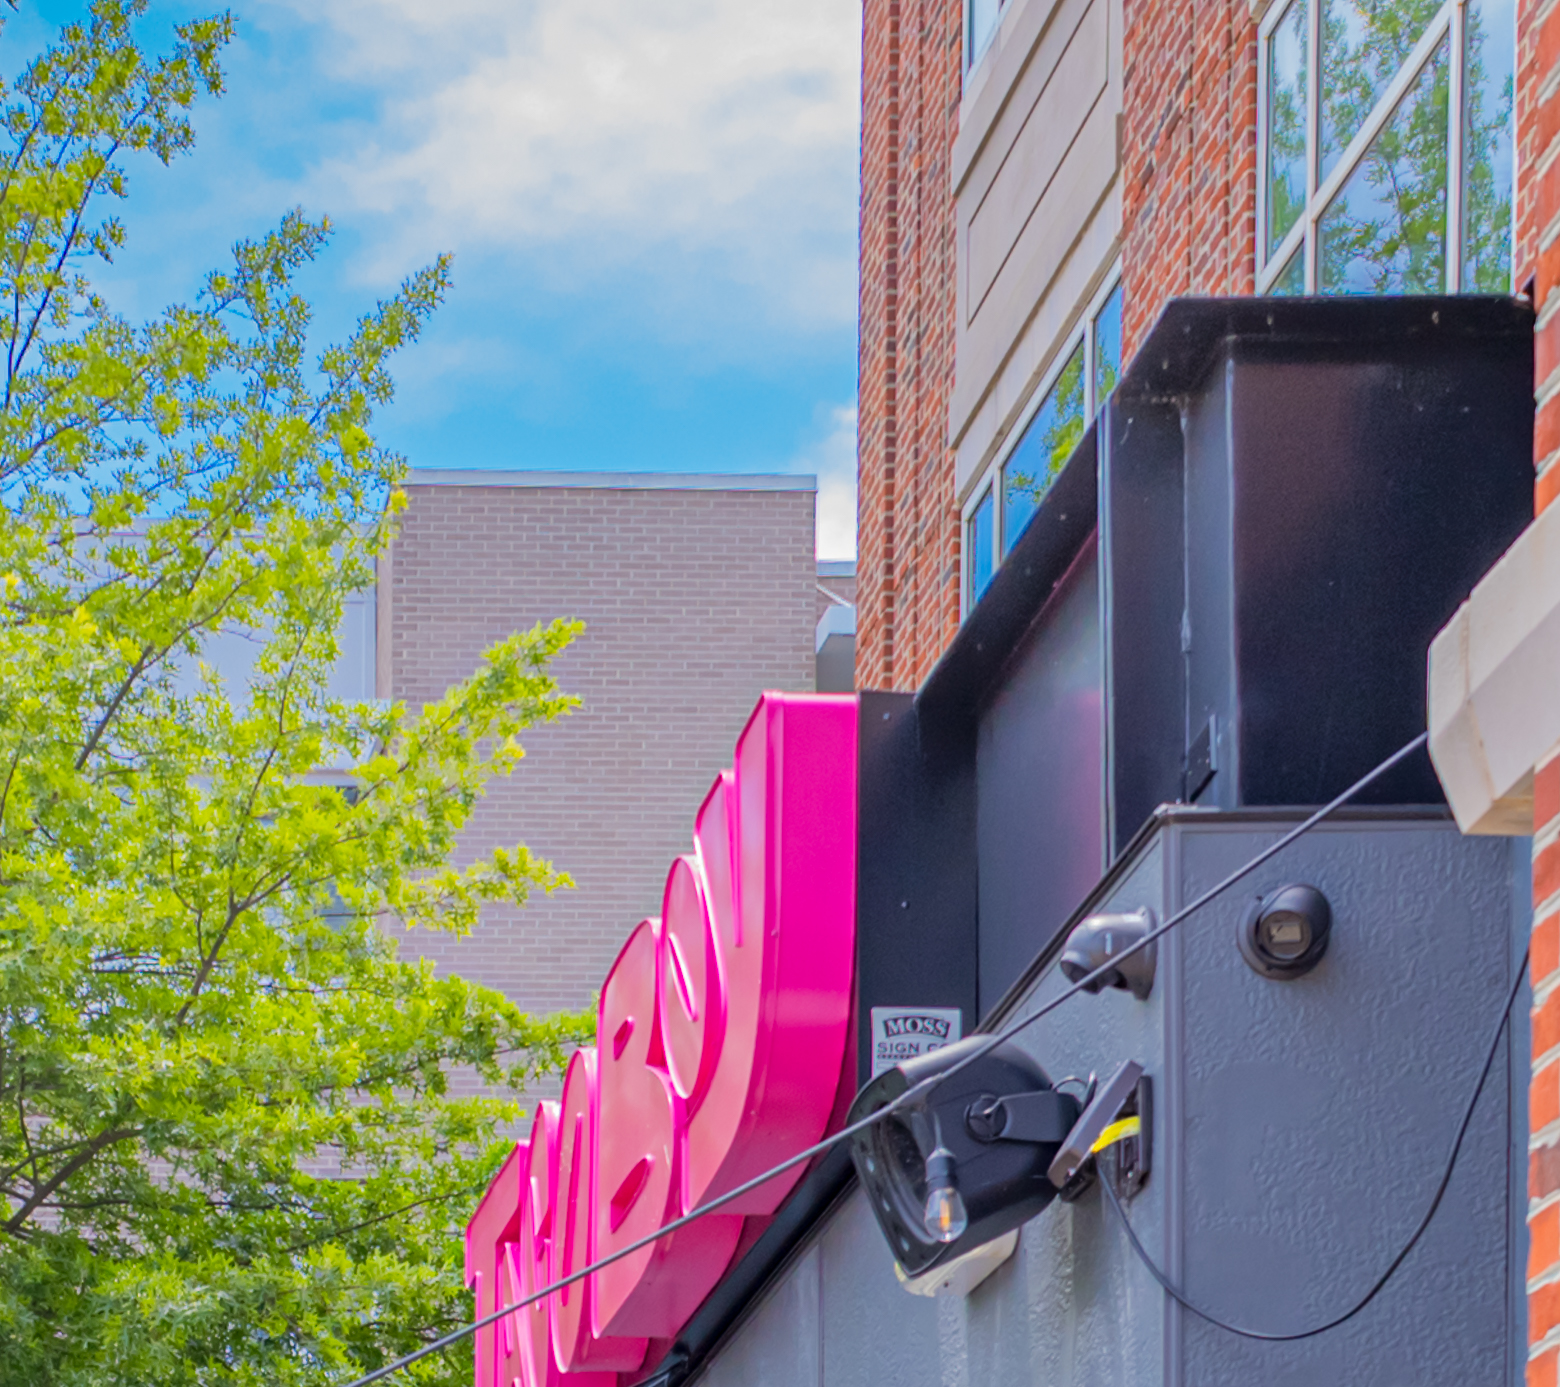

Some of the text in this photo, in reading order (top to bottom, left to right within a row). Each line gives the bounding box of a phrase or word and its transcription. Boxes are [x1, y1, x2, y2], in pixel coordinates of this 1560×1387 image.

[594, 690, 858, 1338] BOY
[886, 1017, 948, 1037] MOSS
[877, 1042, 920, 1053] SIGN
